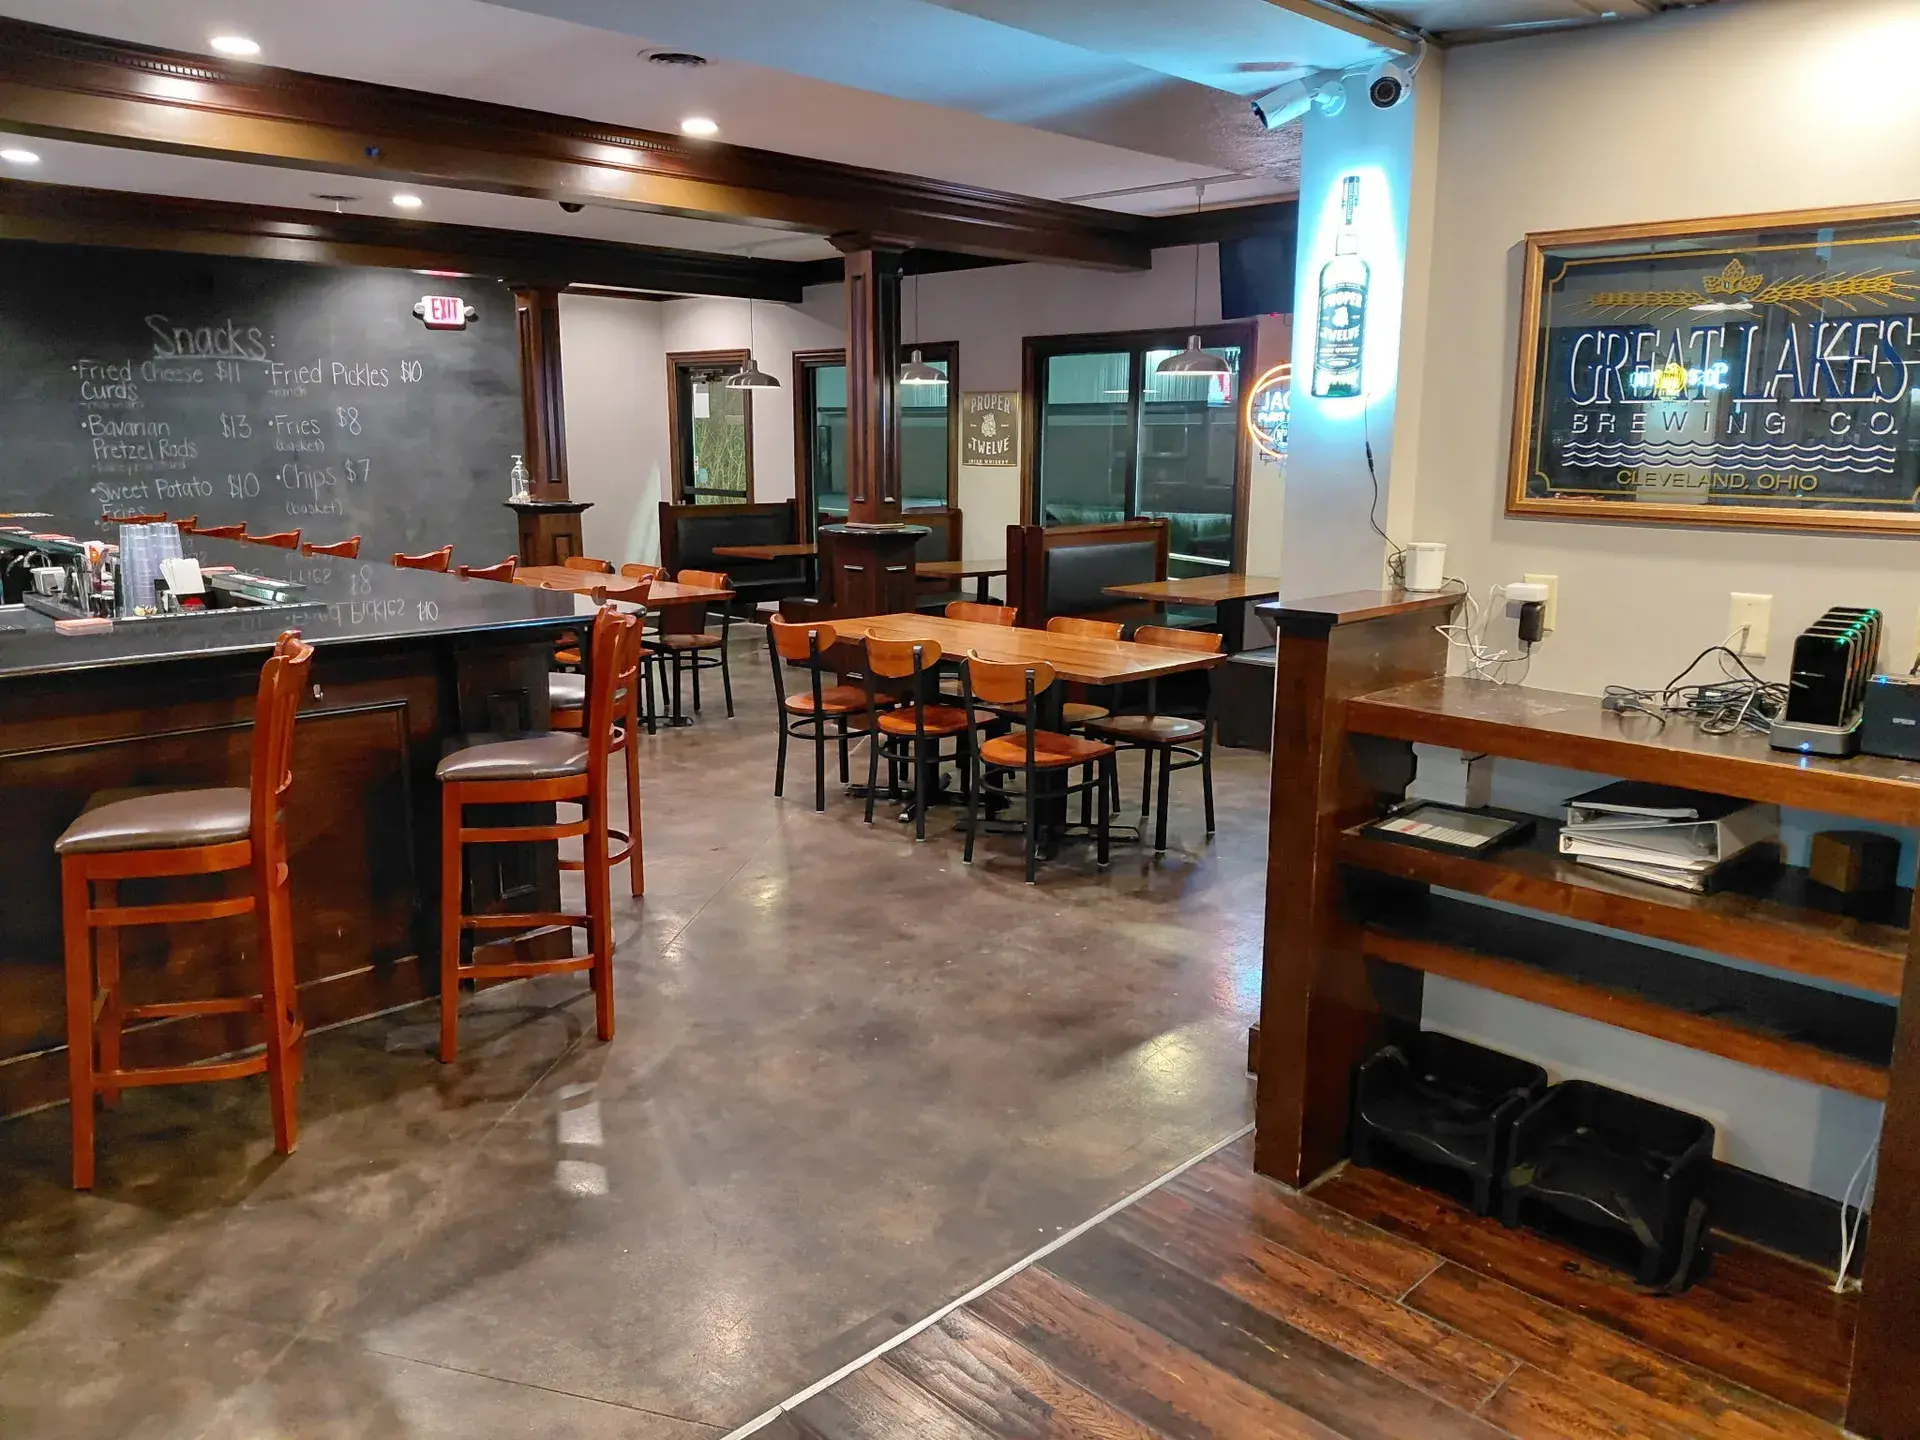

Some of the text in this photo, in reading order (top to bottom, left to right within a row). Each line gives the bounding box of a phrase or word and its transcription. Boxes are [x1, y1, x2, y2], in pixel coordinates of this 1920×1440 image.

[431, 298, 458, 320] EXIT
[78, 360, 241, 382] Fried Cheese $11
[271, 358, 423, 387] Fried Pickles $10
[1570, 326, 1726, 405] GREAT
[1733, 317, 1913, 403] LAKES
[81, 380, 139, 400] Curds
[1261, 391, 1291, 411] JAC
[970, 394, 1011, 414] PROPER
[88, 412, 251, 438] Bavarian $13
[275, 407, 362, 435] Fries $8
[1571, 411, 1899, 435] BREWING CO.
[92, 438, 154, 461] Pretzel
[970, 436, 1010, 455] TWELVE
[98, 472, 260, 503] Sweet Potato $10
[282, 459, 371, 500] Chips $7
[1616, 469, 1818, 491] CLEVELAND, OHIO
